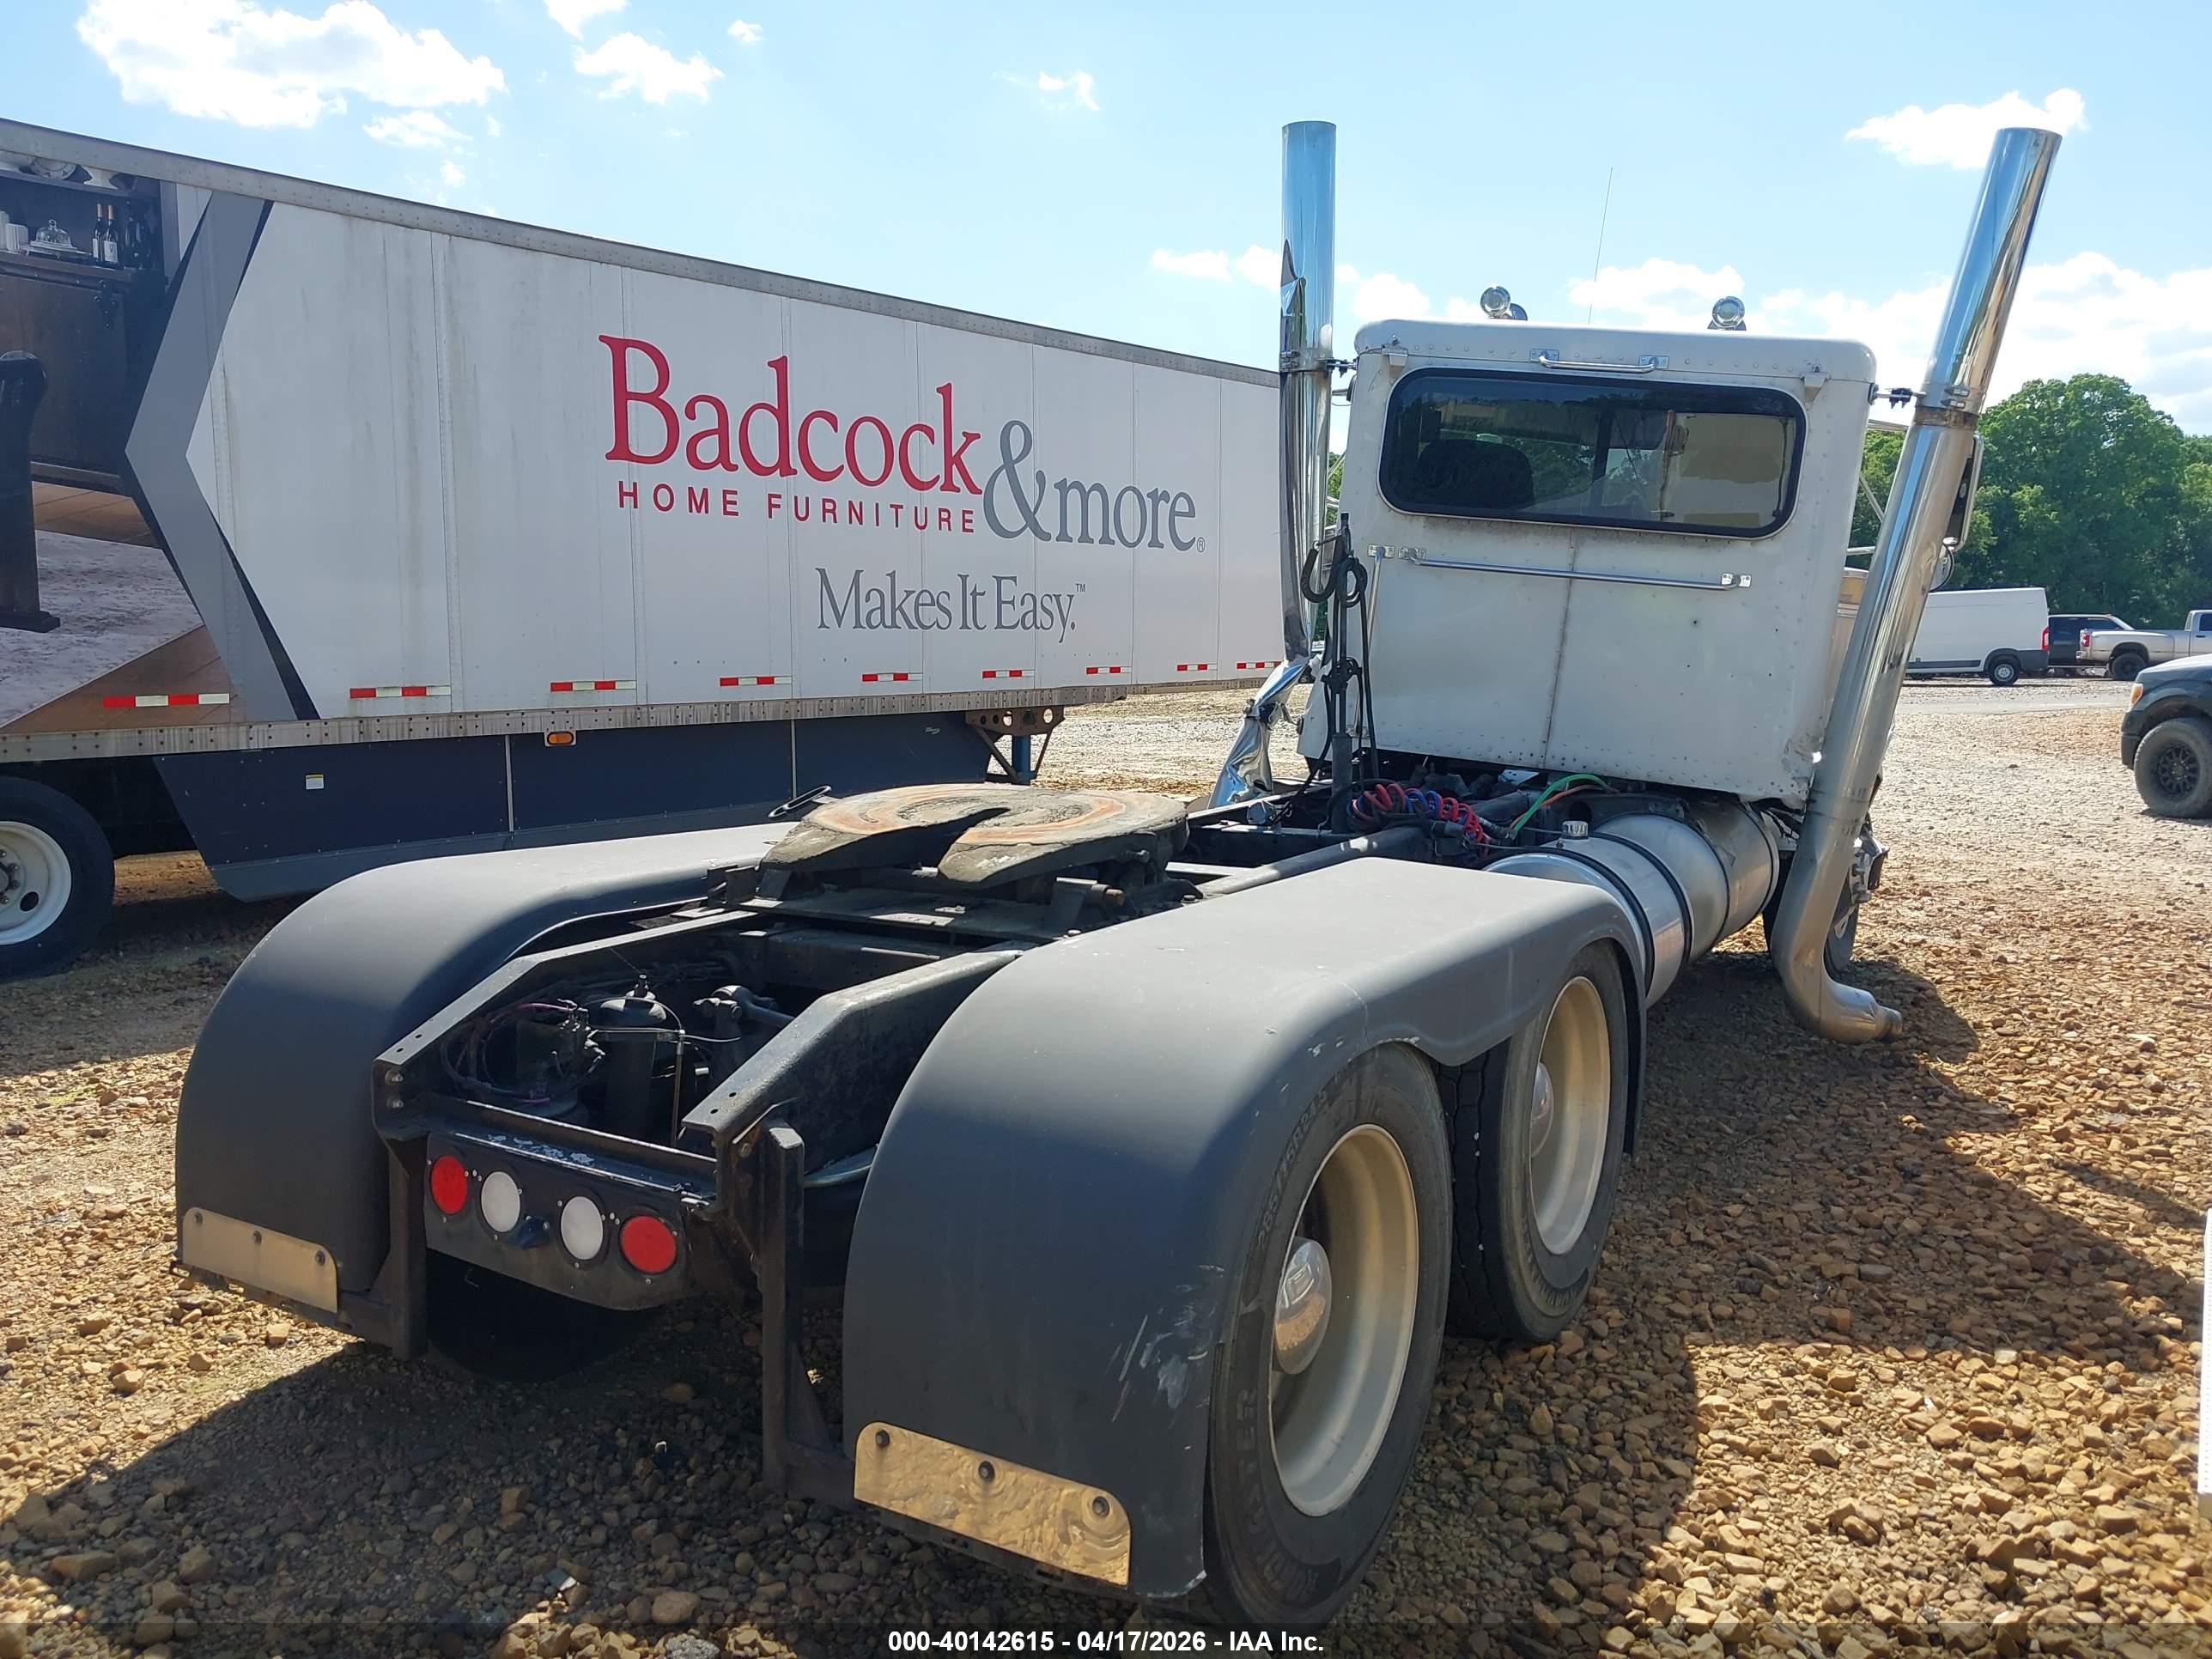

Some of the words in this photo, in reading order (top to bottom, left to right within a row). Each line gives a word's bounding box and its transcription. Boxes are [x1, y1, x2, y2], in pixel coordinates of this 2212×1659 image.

[599, 334, 982, 495] Badcock
[617, 480, 740, 517] HOME
[767, 492, 975, 533] FURNITURE
[815, 567, 952, 631] Makes
[957, 574, 987, 630] It
